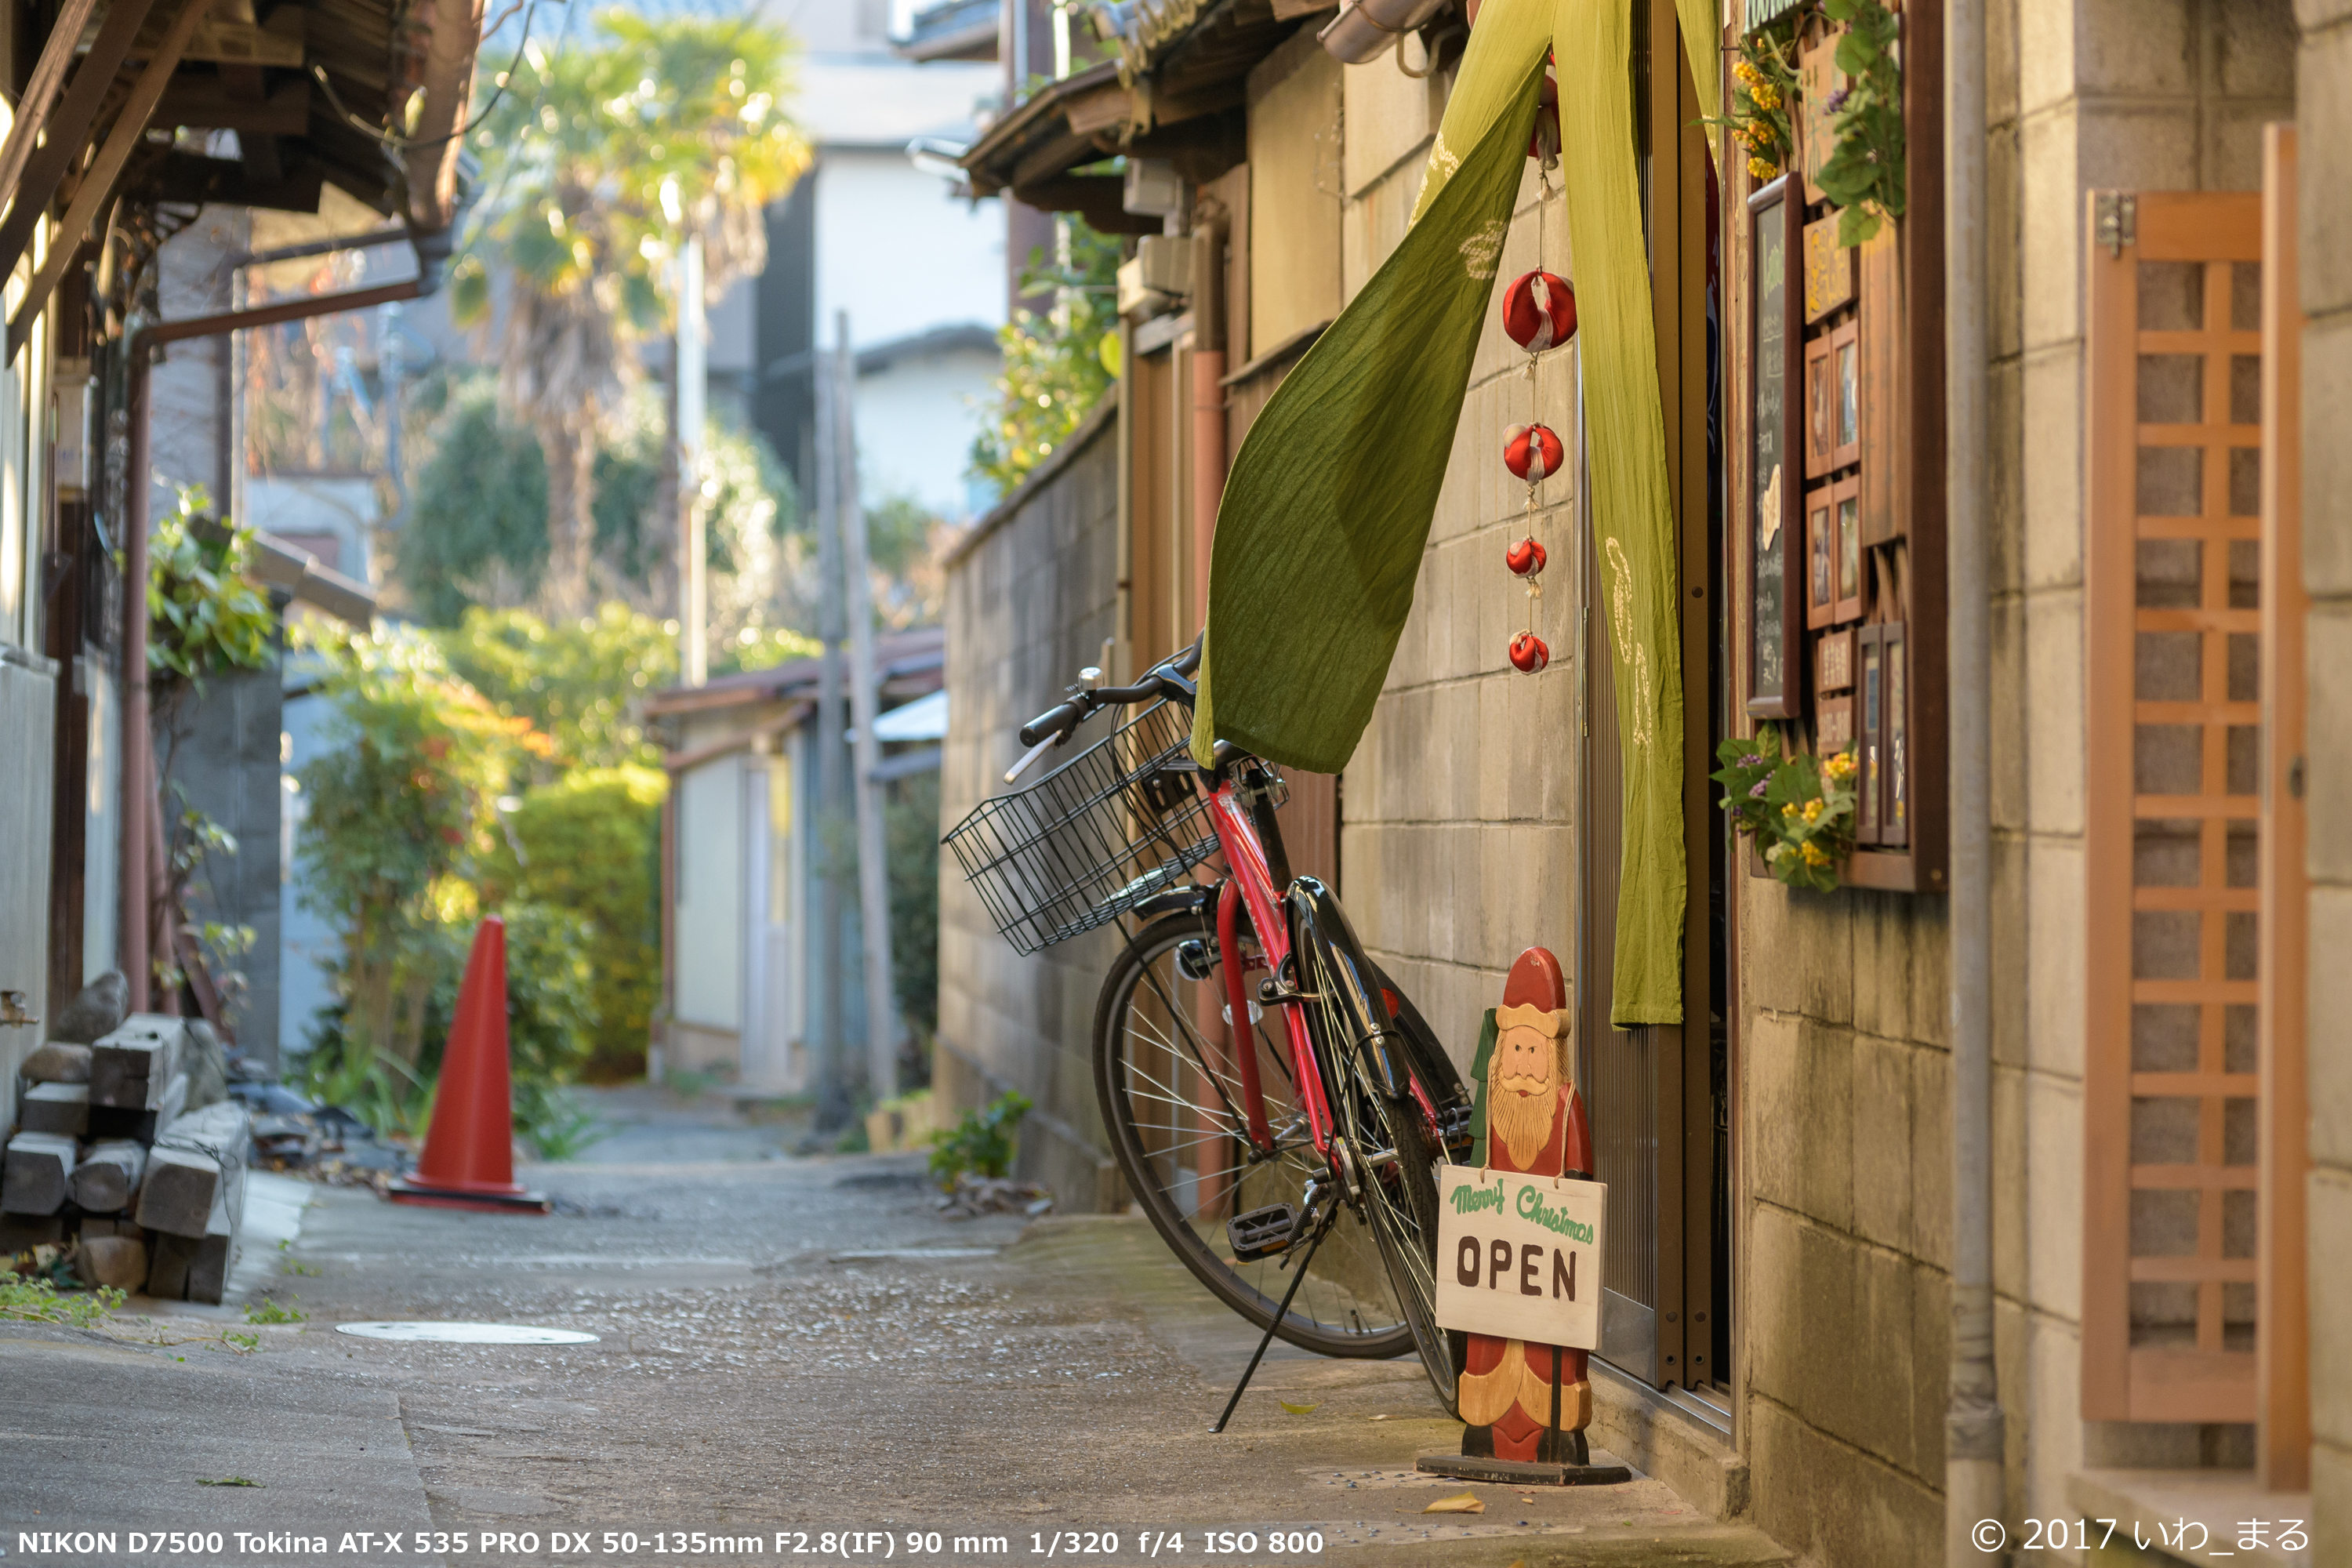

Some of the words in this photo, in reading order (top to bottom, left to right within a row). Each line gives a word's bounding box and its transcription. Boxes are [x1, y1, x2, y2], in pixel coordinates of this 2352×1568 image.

[1450, 1178, 1505, 1215] Merry
[1515, 1185, 1594, 1245] Christmas
[1457, 1236, 1577, 1302] OPEN
